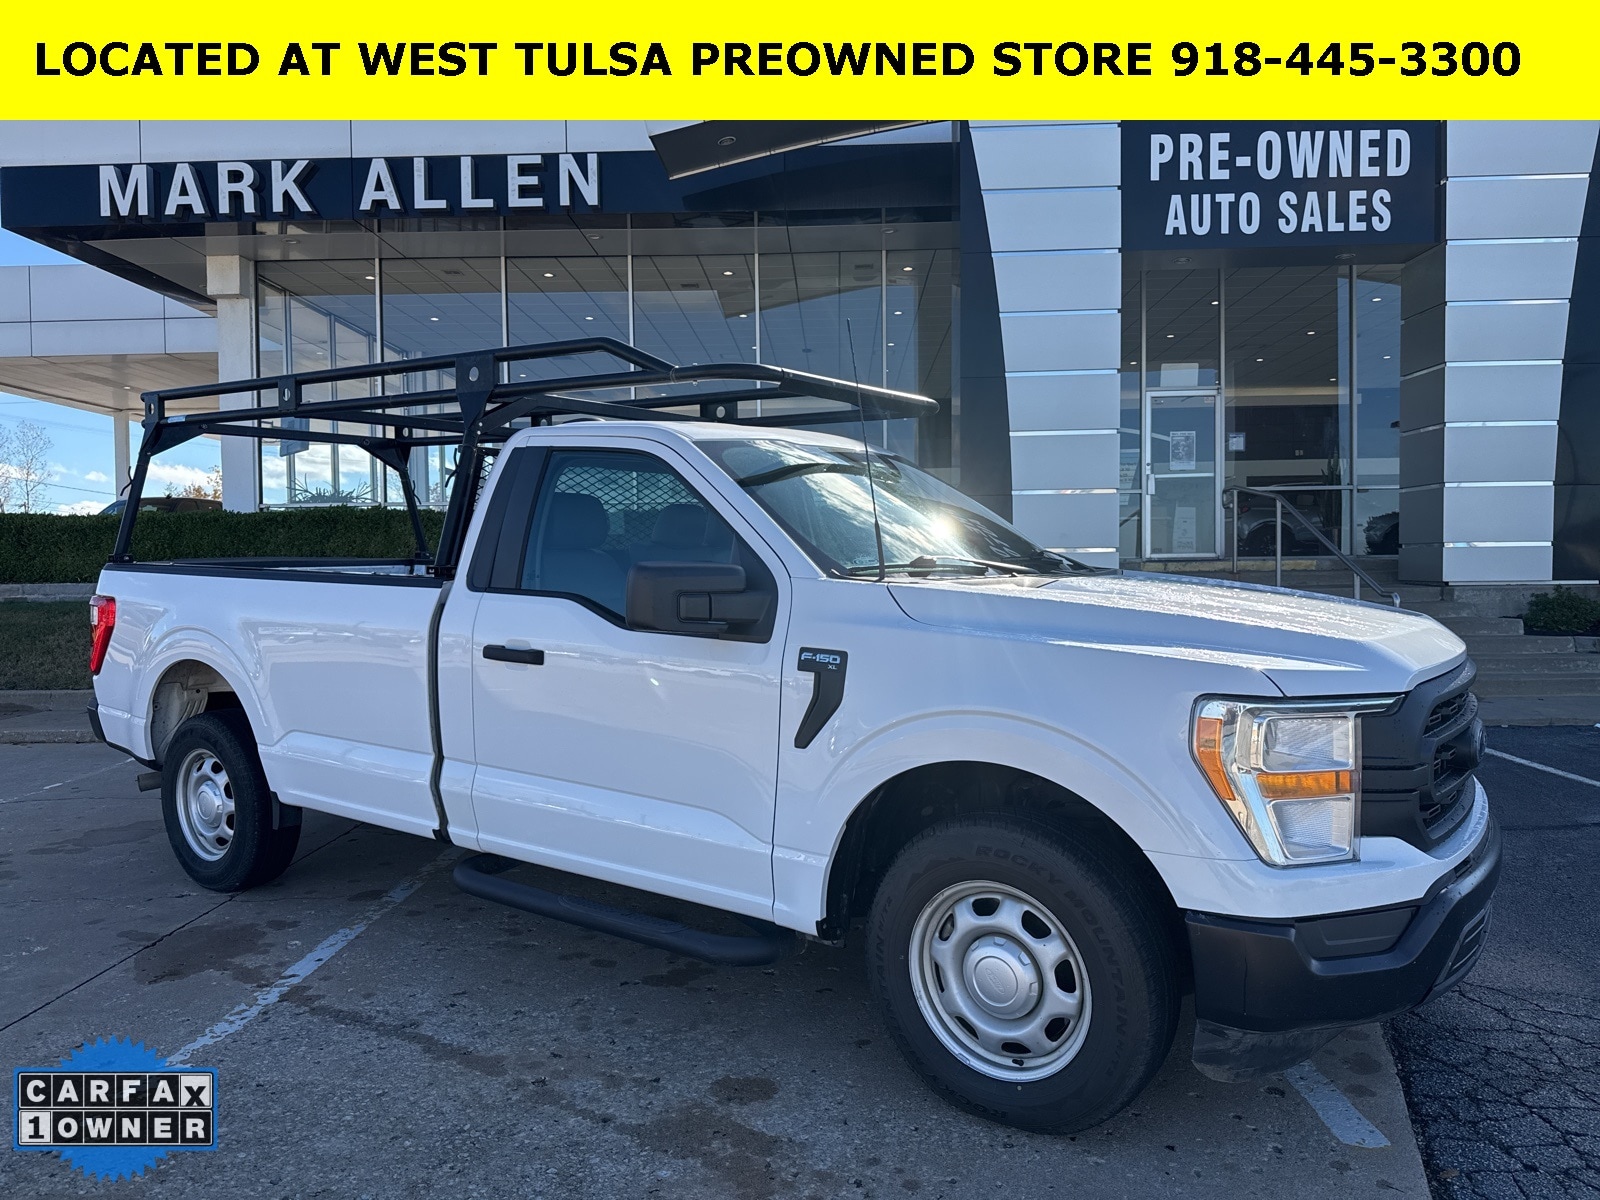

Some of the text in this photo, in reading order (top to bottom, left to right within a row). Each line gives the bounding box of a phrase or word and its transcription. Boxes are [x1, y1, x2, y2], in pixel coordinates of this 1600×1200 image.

[1150, 129, 1411, 181] PRE-OWNED
[98, 152, 601, 217] MARK ALLEN
[1164, 188, 1392, 236] AUTO SALES
[800, 651, 841, 664] F-150
[974, 845, 1067, 886] ROCKY
[1063, 889, 1131, 1036] MOUNTAIN
